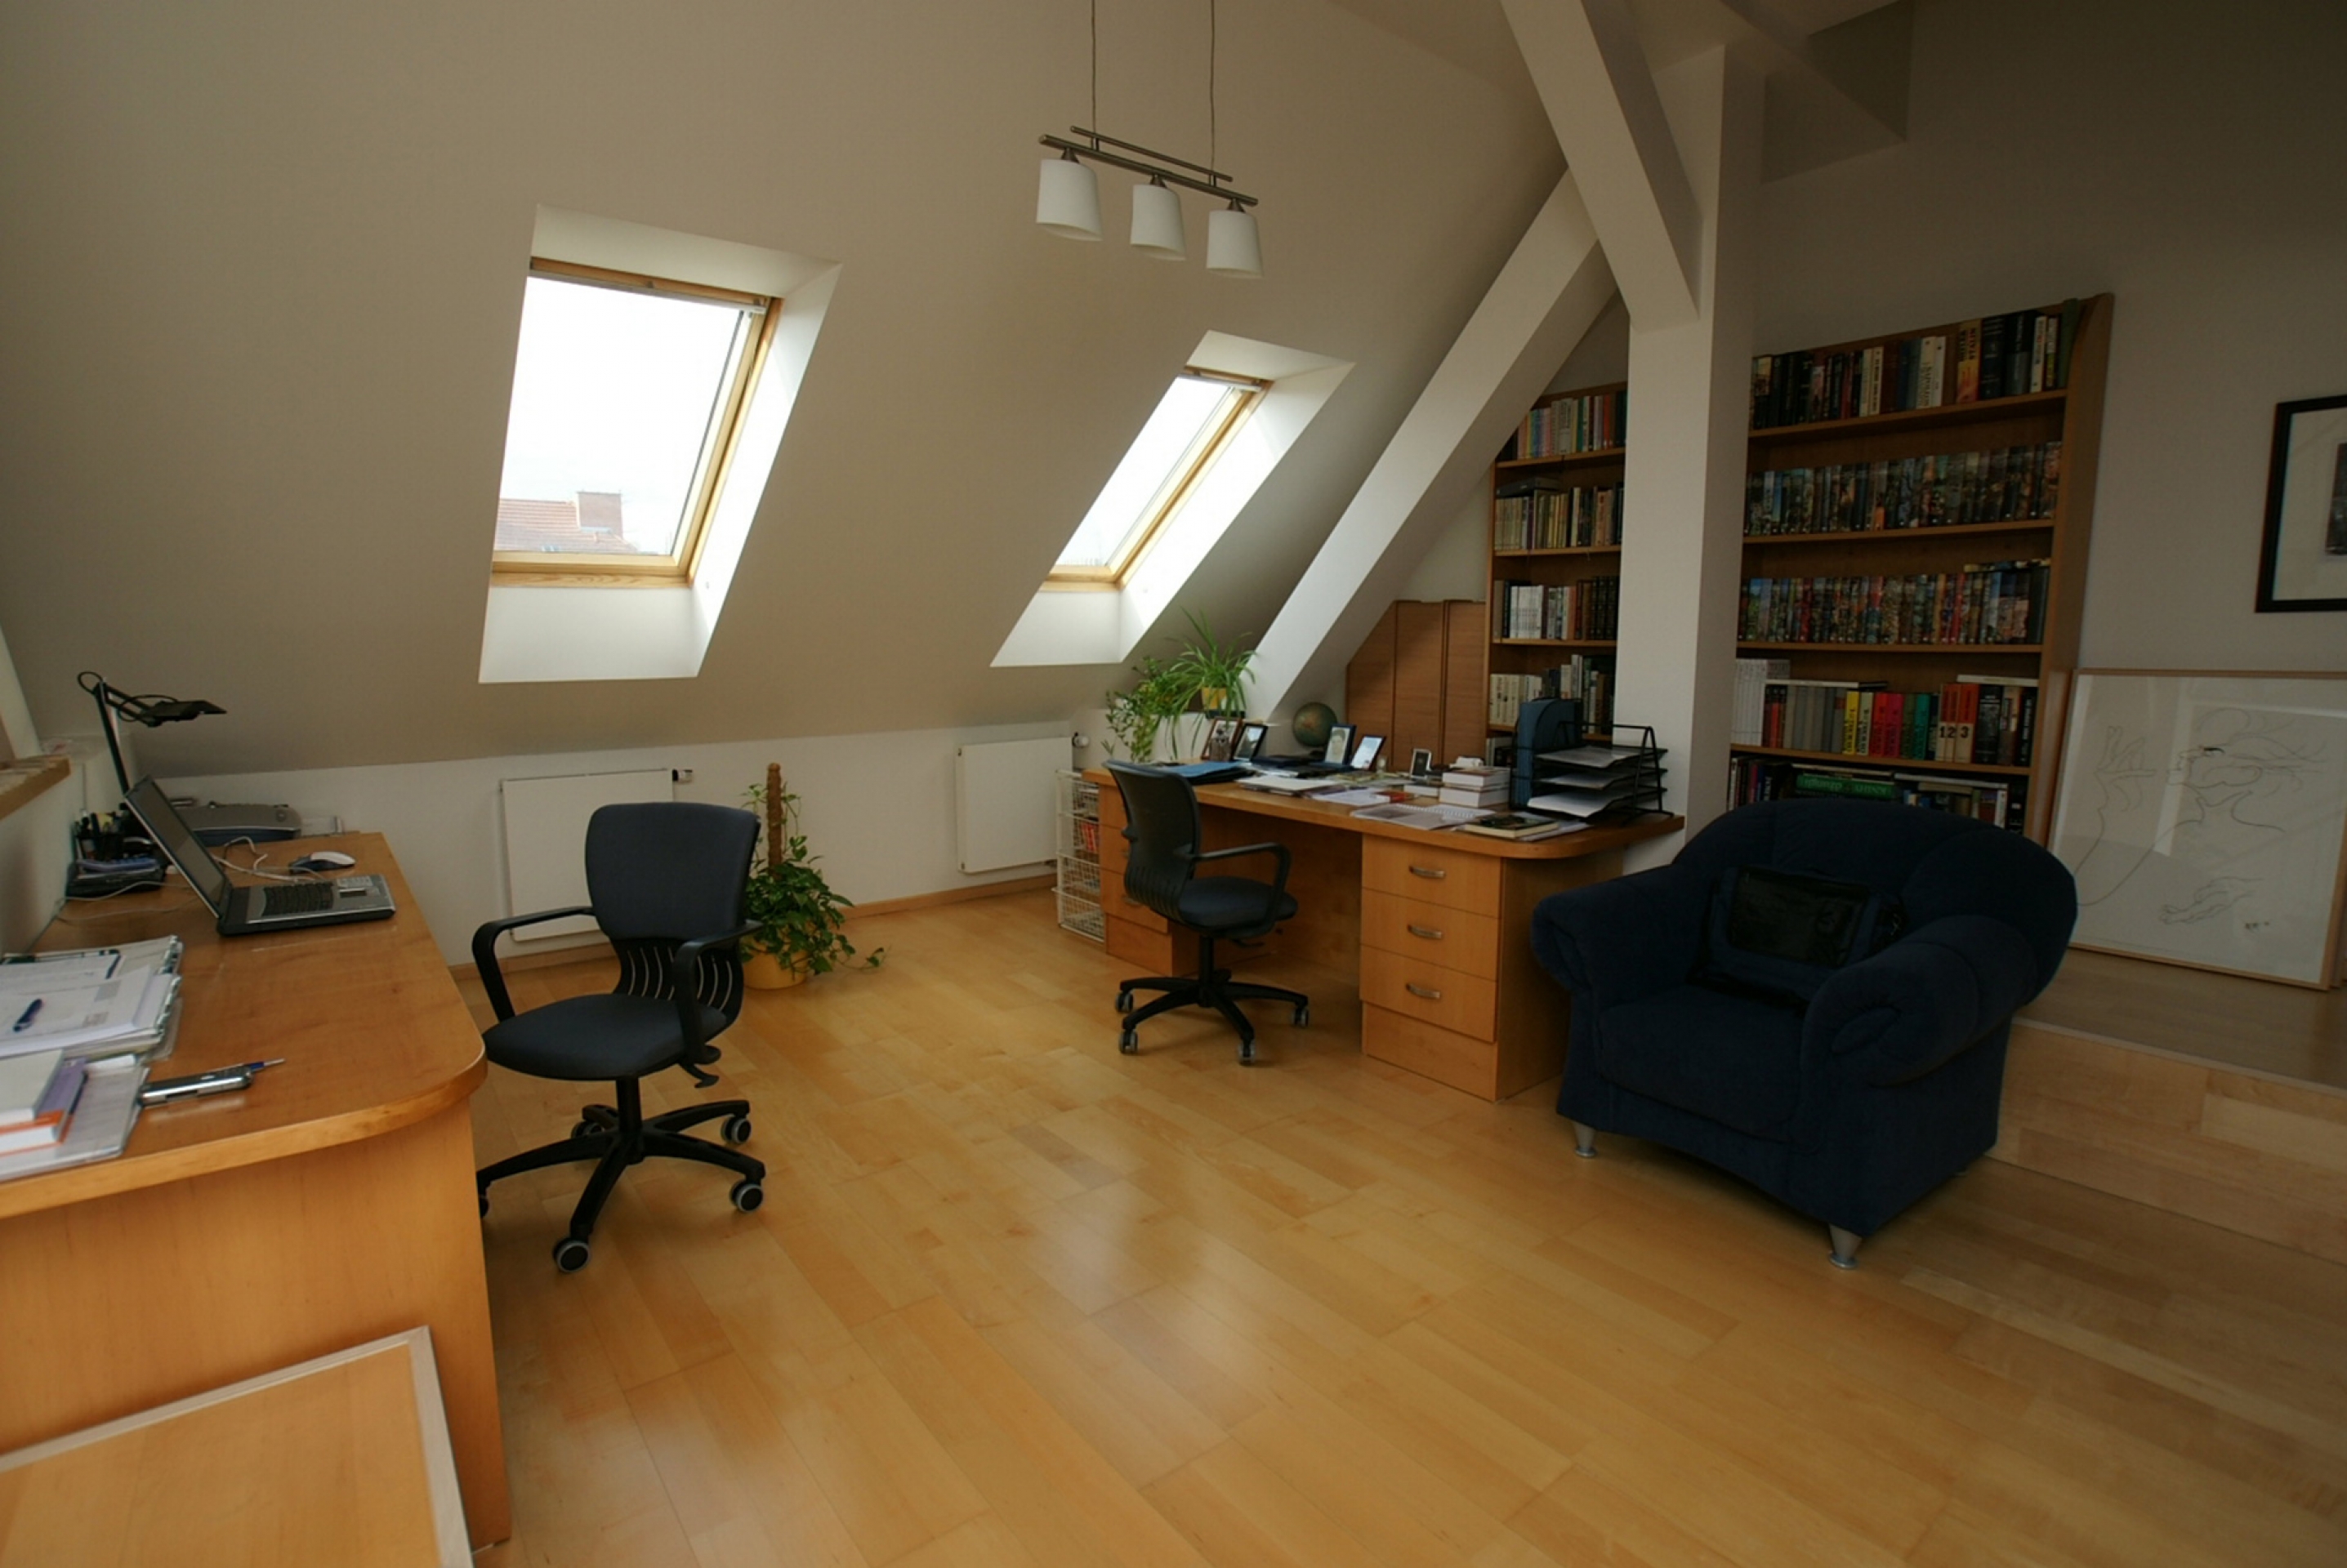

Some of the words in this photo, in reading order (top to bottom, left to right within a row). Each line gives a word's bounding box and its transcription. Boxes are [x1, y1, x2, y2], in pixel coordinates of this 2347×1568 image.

[1940, 726, 1946, 738] 1
[1948, 726, 1957, 738] 2
[1961, 726, 1969, 738] 3
